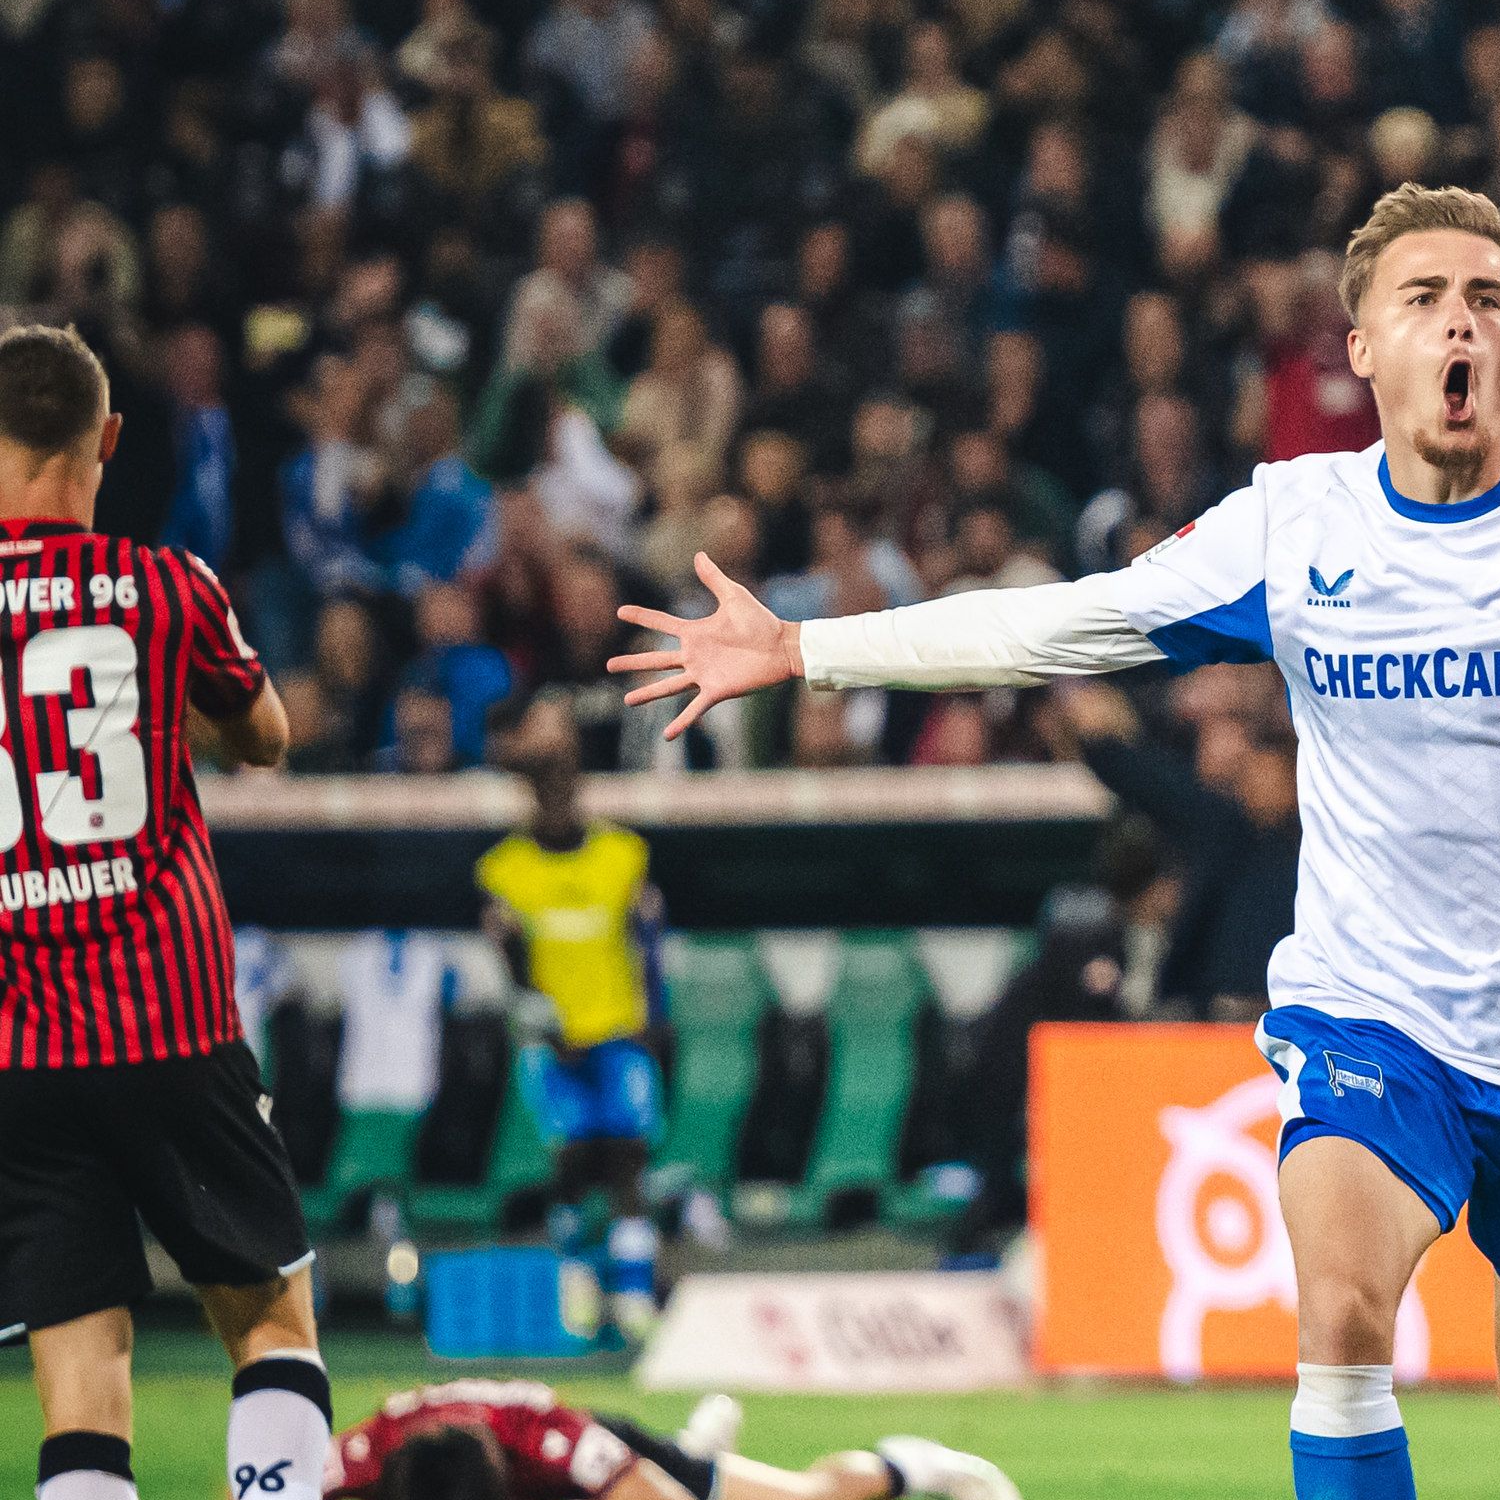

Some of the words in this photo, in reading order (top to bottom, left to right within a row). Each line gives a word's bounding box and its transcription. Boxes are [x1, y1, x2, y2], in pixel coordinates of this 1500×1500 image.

[0, 577, 76, 616] VER
[89, 573, 139, 609] 96
[235, 1459, 293, 1500] 96
